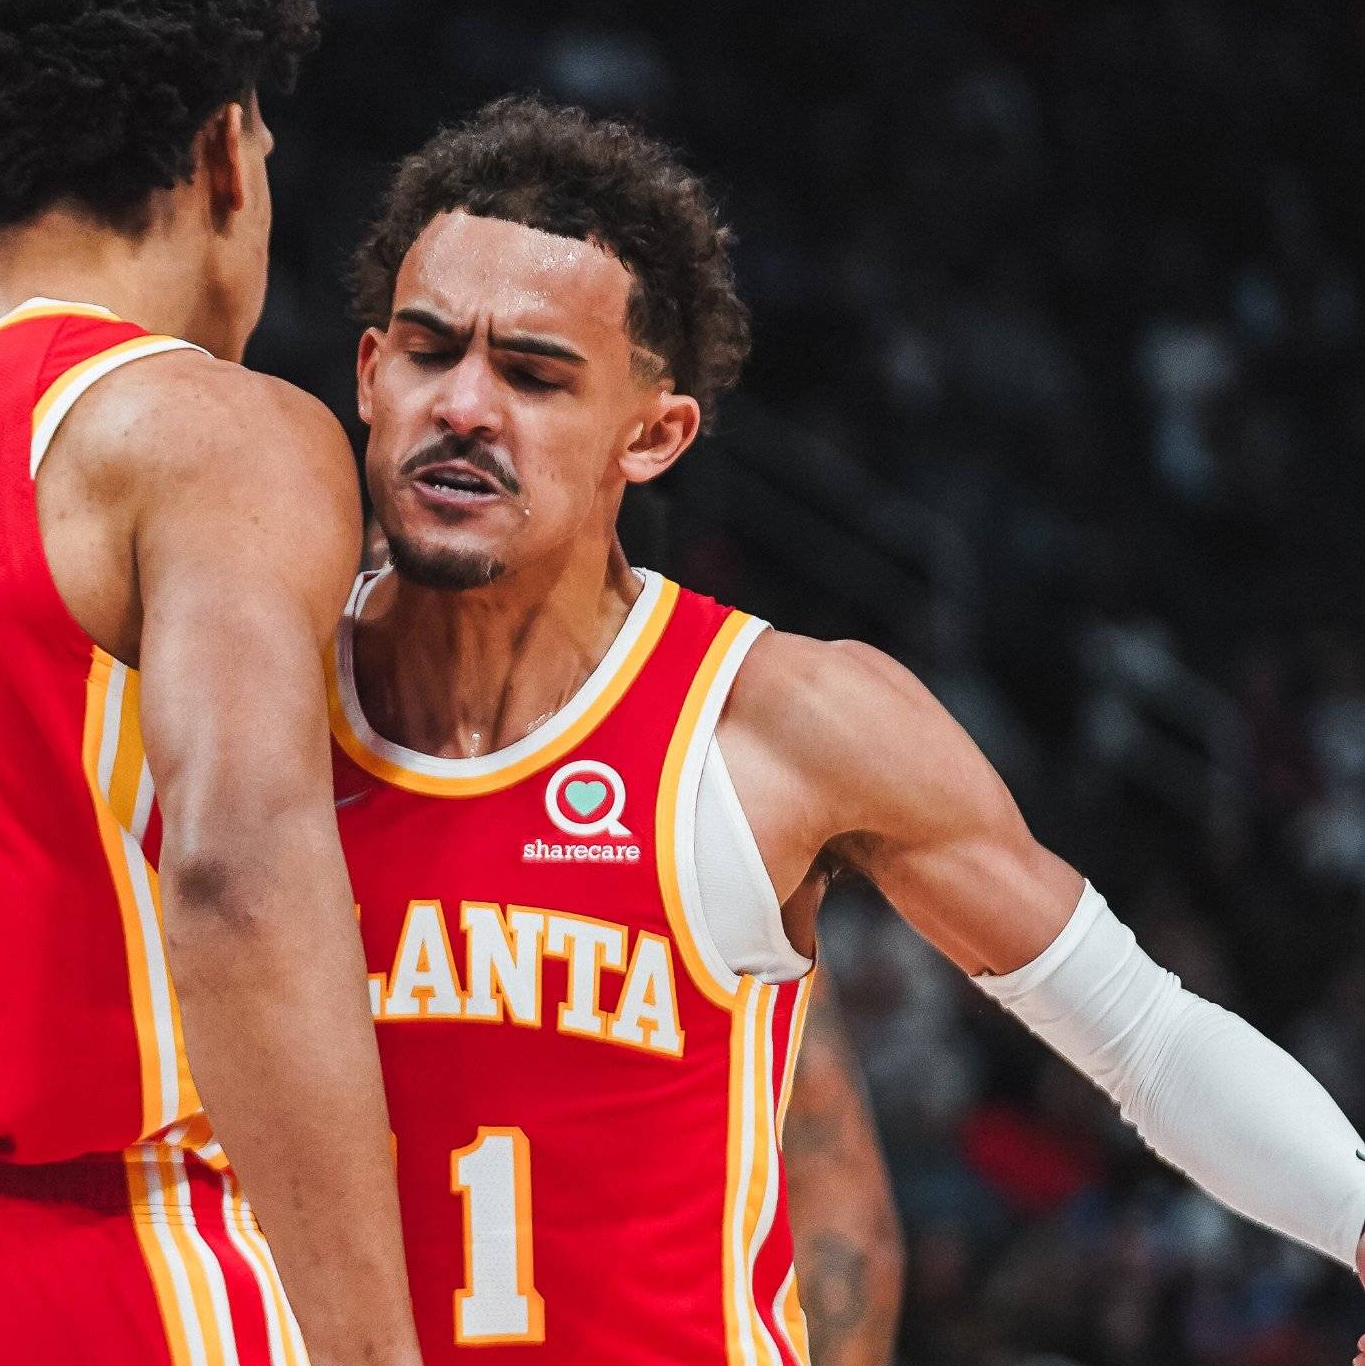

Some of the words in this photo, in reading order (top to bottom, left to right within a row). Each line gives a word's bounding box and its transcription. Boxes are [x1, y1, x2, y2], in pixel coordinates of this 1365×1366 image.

[522, 837, 642, 862] sharecare
[367, 899, 686, 1059] ANTA
[387, 1126, 546, 1347] 1
